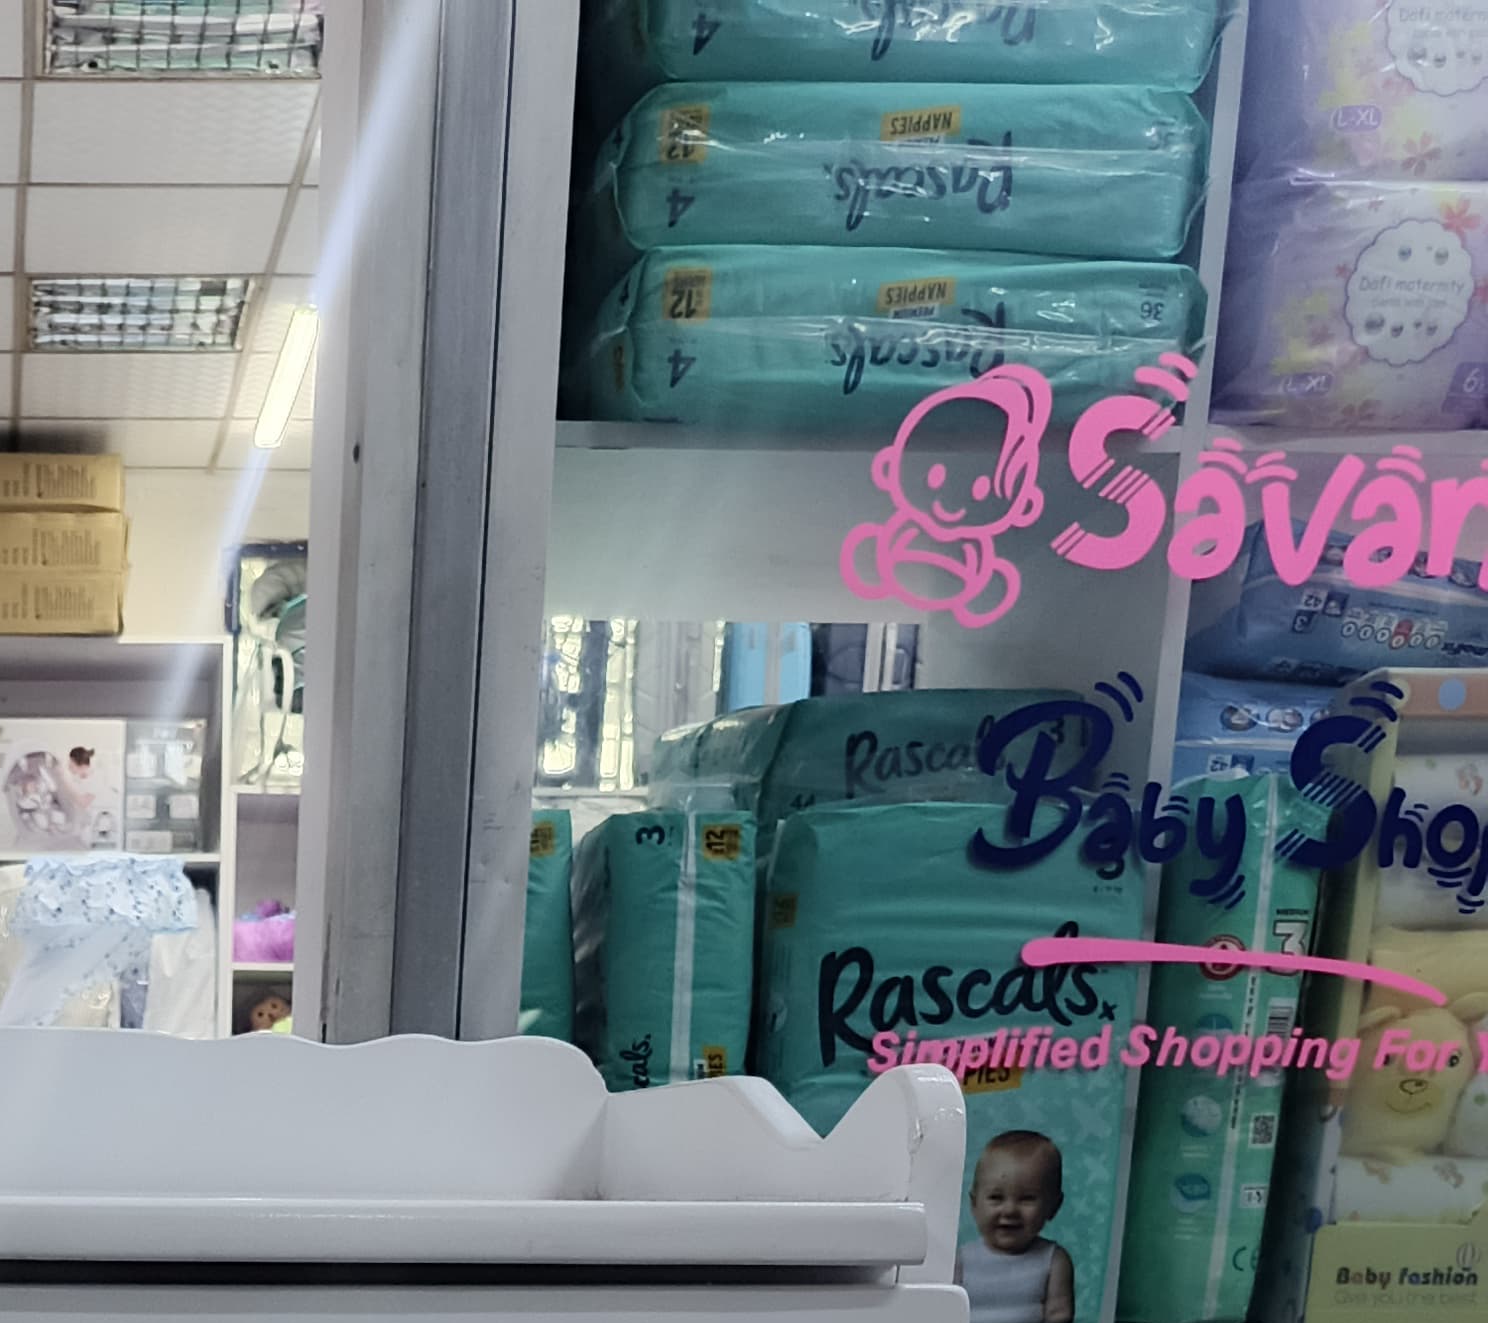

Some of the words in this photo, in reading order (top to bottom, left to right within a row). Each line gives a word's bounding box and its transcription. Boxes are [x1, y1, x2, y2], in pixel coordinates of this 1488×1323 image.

[889, 111, 954, 136] NAPPIES
[666, 188, 696, 228] 4
[884, 282, 947, 304] NAPPIES
[1140, 302, 1164, 321] 36
[667, 349, 697, 389] 4
[845, 715, 1002, 800] Rasca
[970, 698, 1248, 898] Baby
[635, 825, 666, 846] 3
[818, 920, 1100, 1068] Rascals
[867, 1024, 1112, 1076] Simplified
[1120, 1024, 1361, 1080] Shopping
[1373, 1028, 1462, 1071] For
[1336, 1266, 1392, 1290] Baby
[1398, 1265, 1479, 1286] fashion
